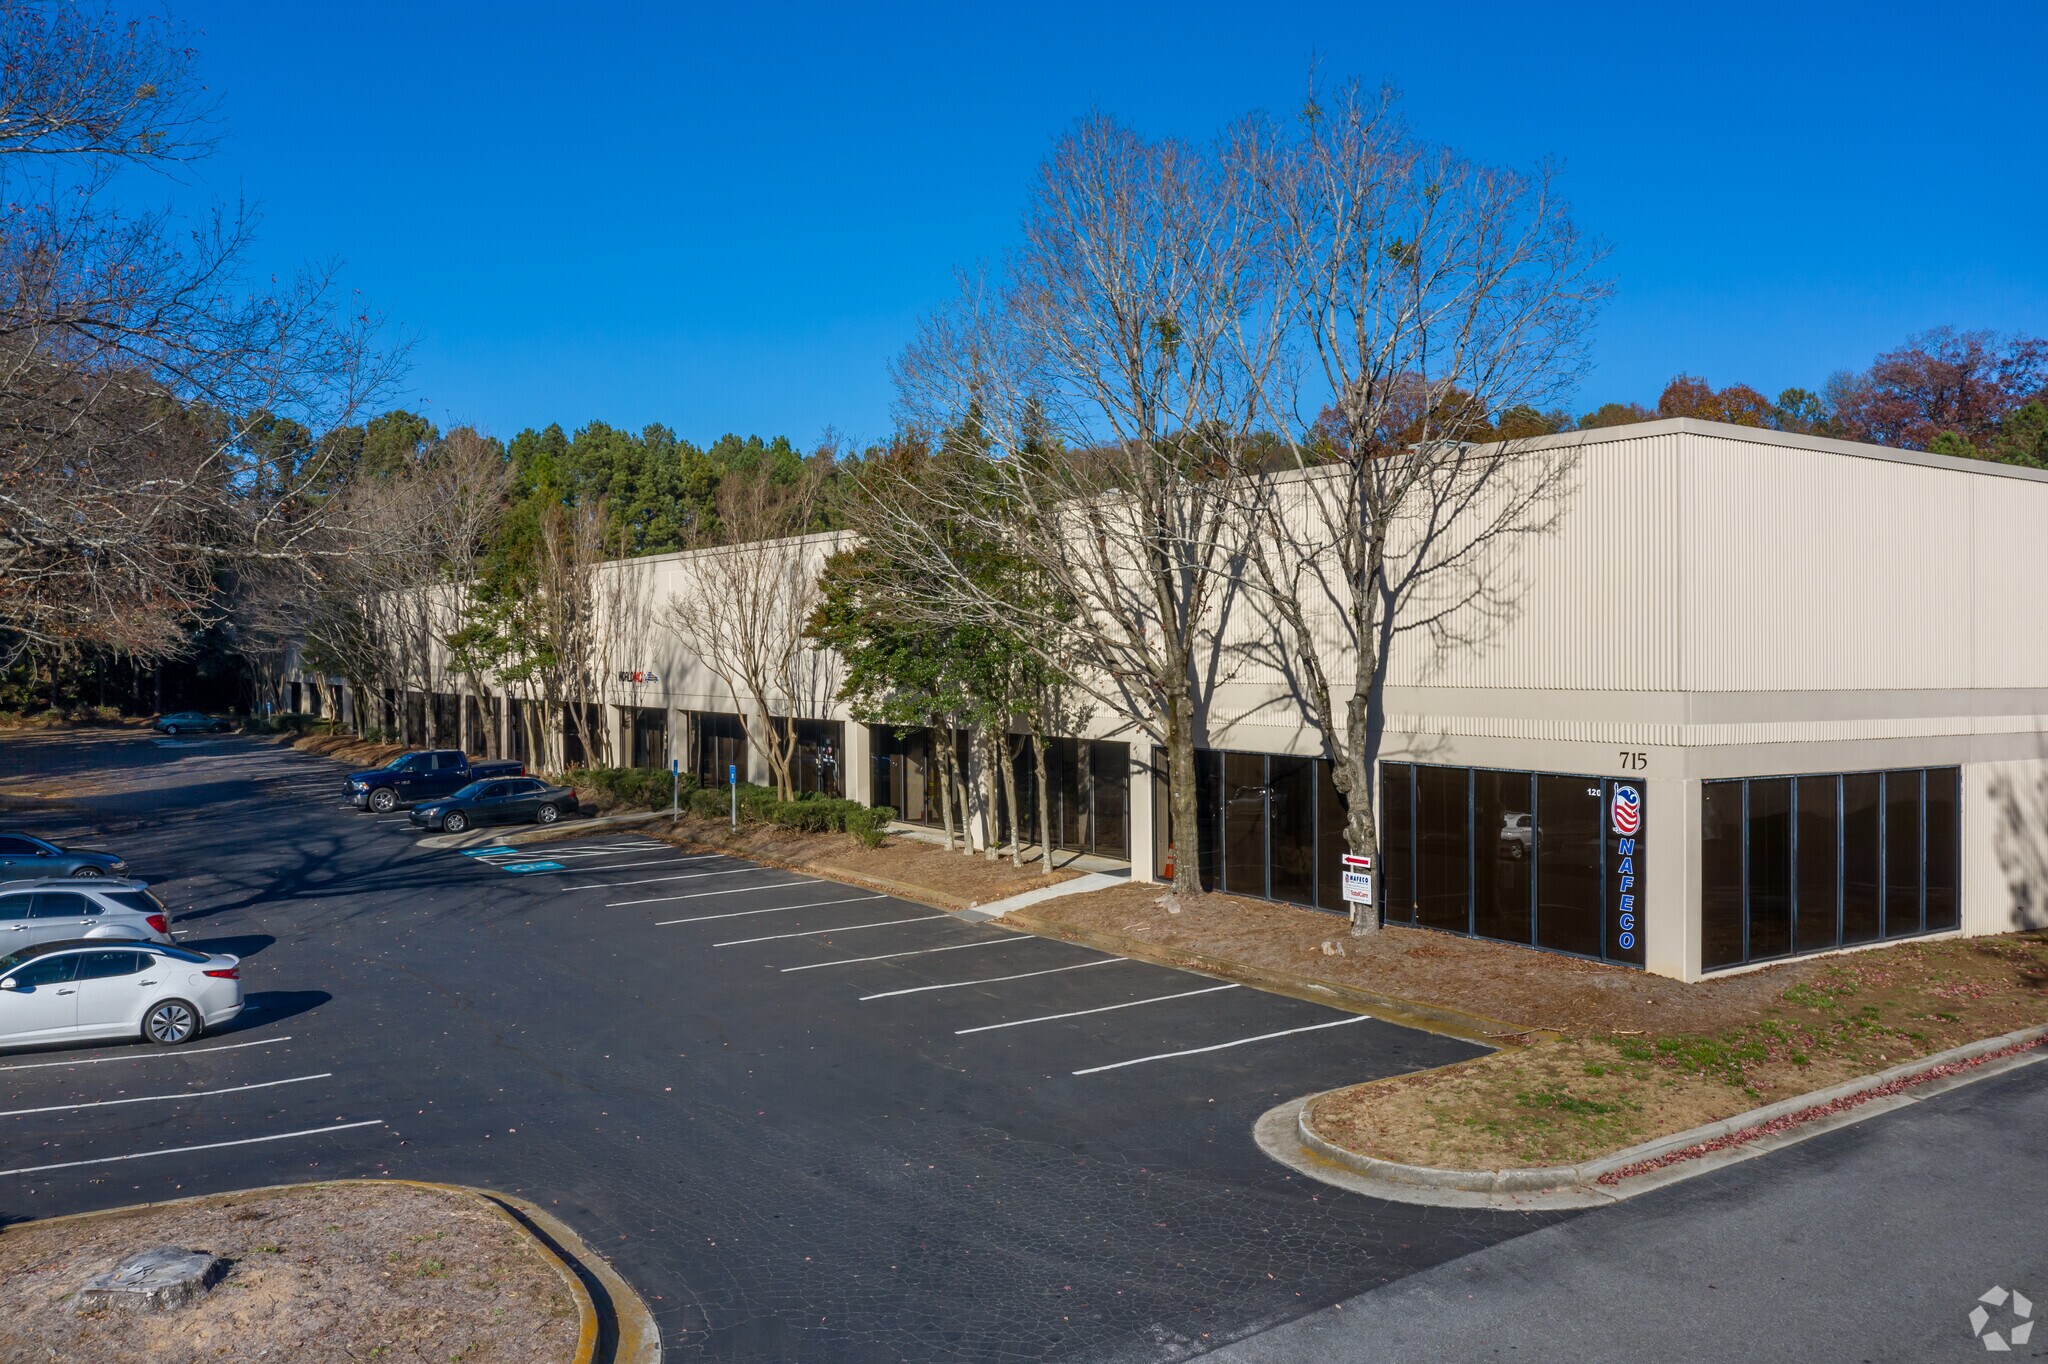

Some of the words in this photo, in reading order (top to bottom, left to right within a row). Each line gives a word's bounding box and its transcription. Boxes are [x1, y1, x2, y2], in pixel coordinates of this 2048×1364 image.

[1619, 752, 1648, 770] 715
[1587, 788, 1601, 797] 120
[1350, 875, 1369, 883] NAFECO
[1618, 838, 1635, 949] NAFECO
